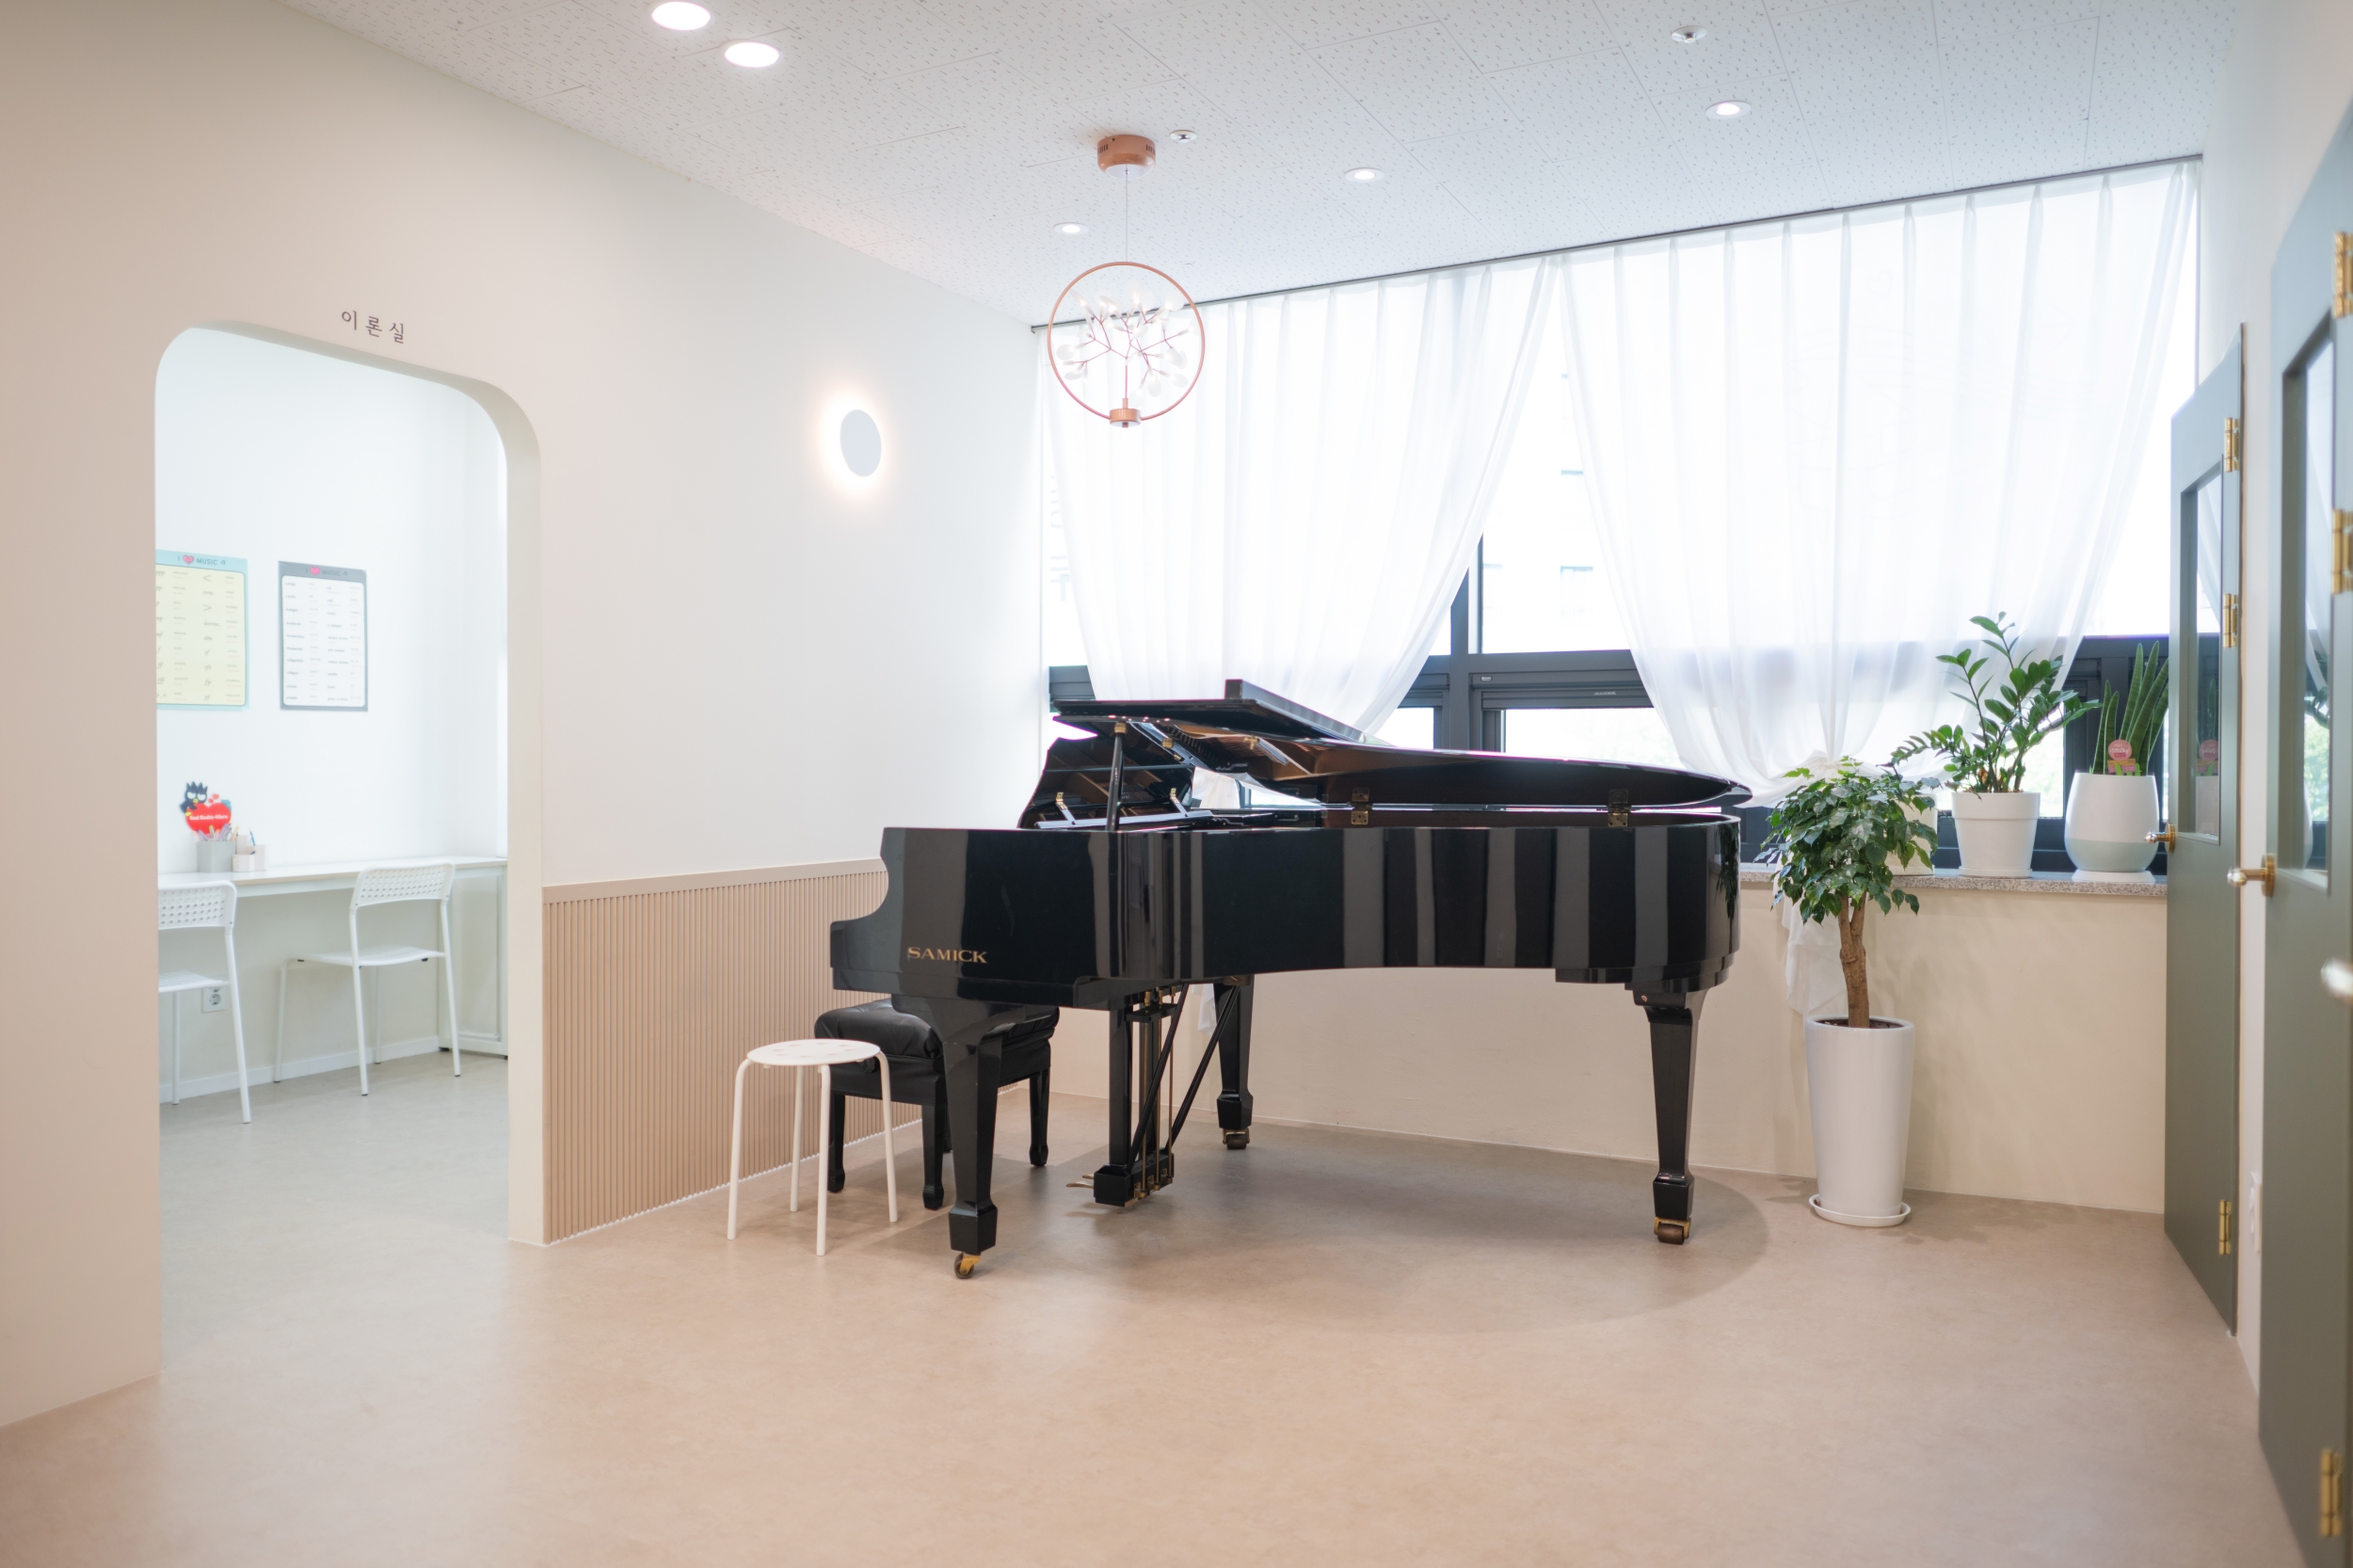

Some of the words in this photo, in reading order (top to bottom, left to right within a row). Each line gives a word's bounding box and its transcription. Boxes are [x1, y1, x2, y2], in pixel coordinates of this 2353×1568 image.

[341, 310, 404, 344] 이론실
[196, 557, 217, 566] MUSIC
[907, 946, 988, 964] SAMICK
